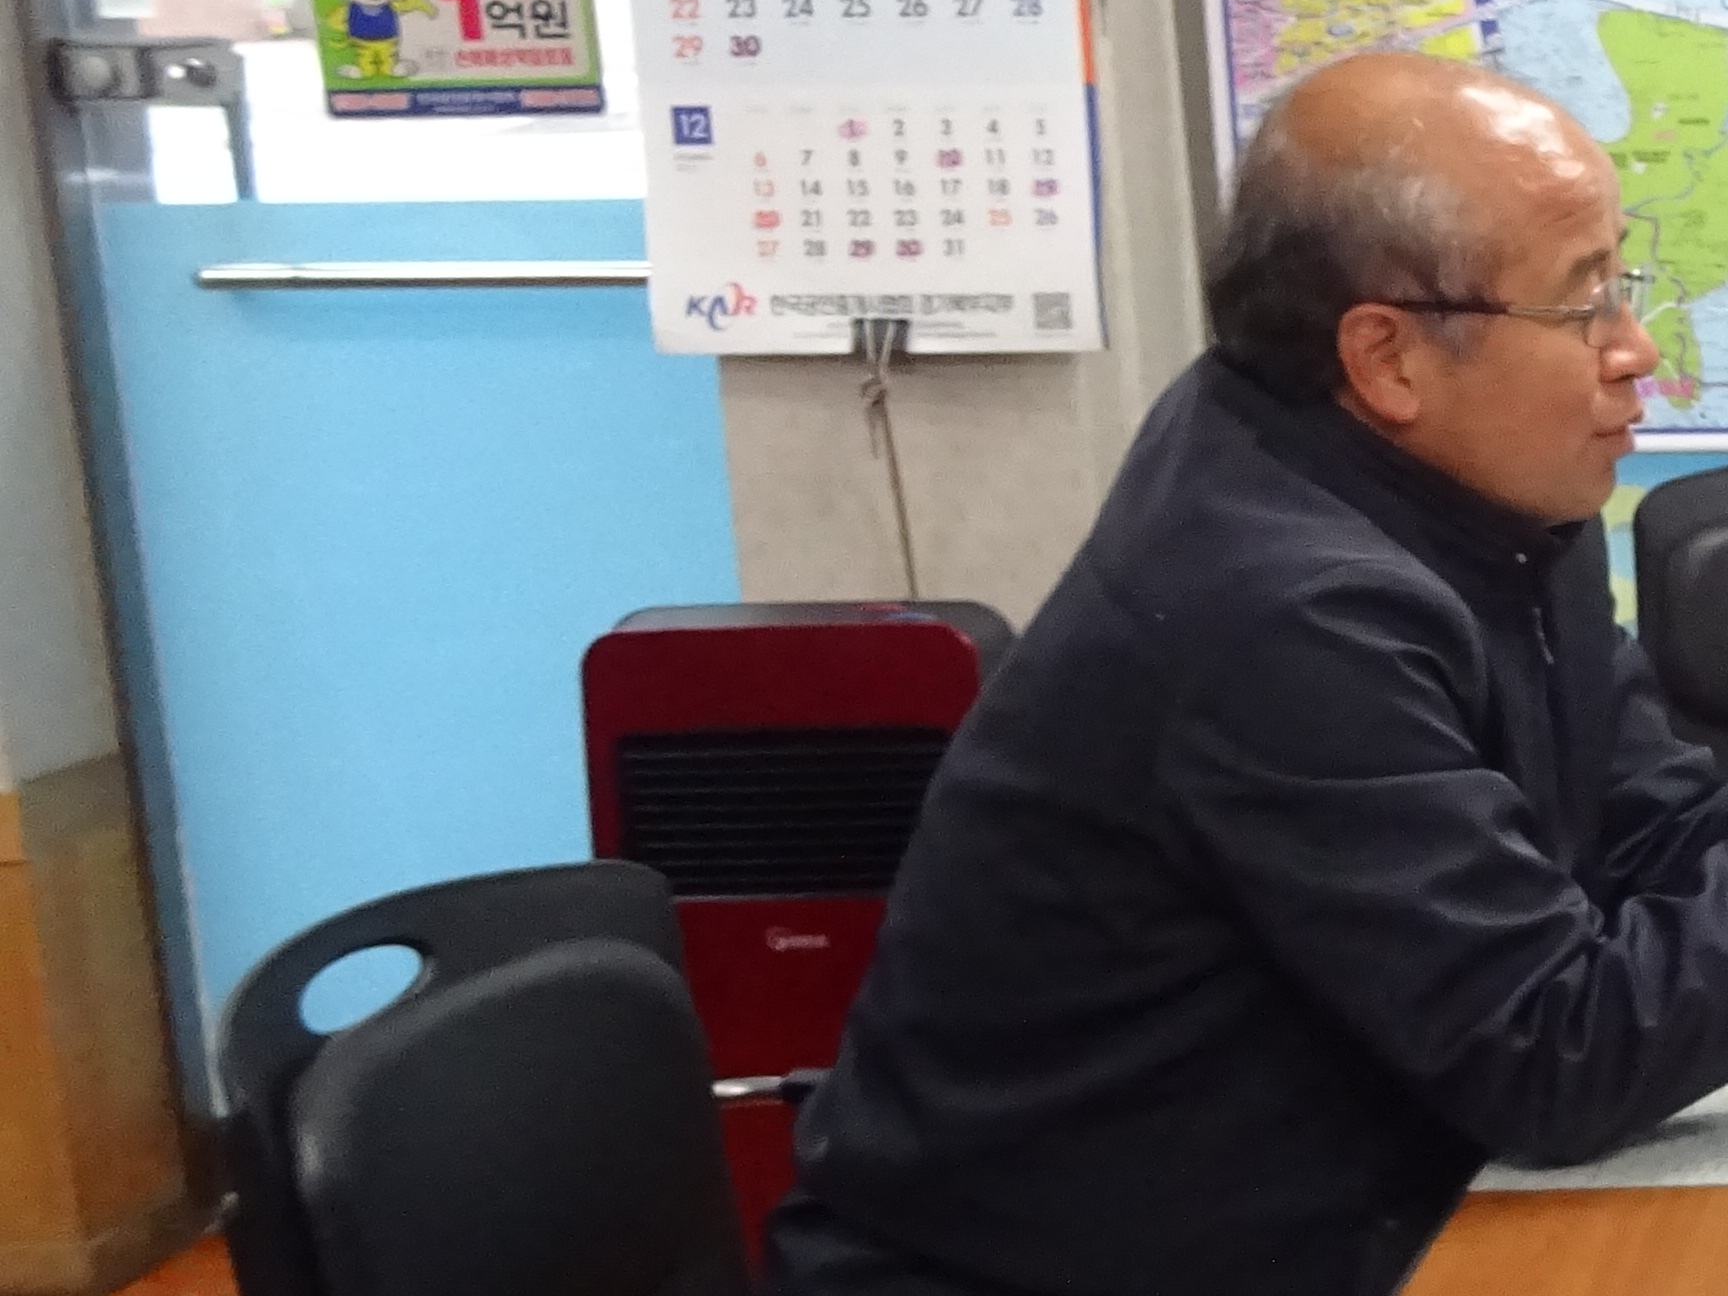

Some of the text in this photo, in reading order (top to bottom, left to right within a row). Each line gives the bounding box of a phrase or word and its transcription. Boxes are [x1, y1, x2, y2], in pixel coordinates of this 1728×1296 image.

[673, 35, 761, 57] 29 30
[680, 114, 709, 138] 12
[1033, 150, 1054, 166] 12
